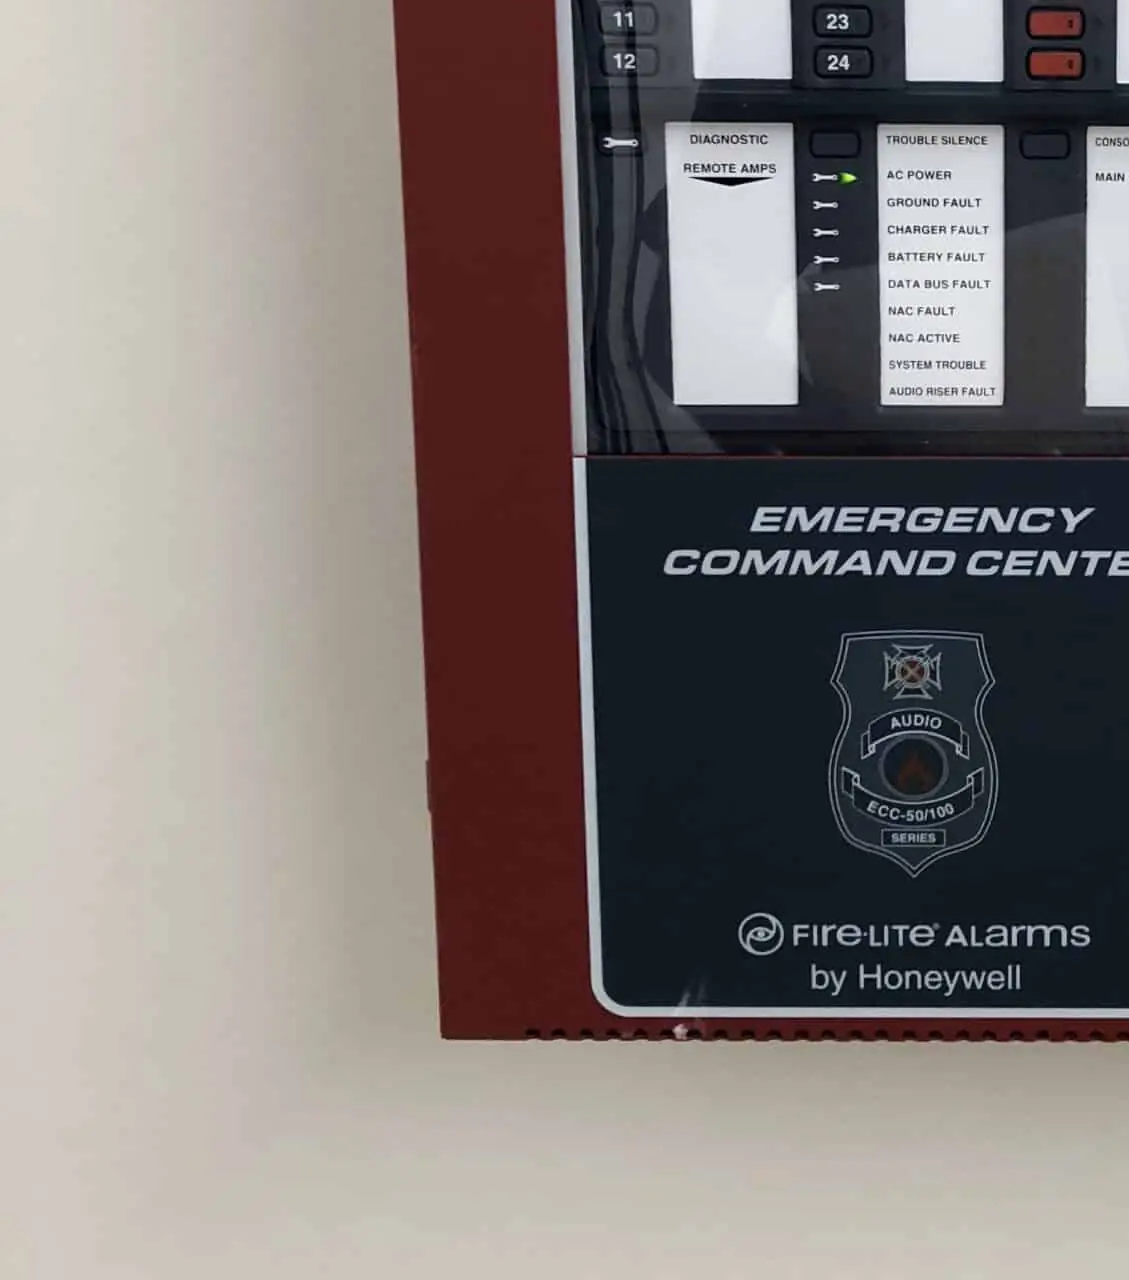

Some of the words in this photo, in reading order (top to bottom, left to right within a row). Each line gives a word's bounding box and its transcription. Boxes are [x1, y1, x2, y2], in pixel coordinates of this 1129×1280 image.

[613, 12, 633, 27] 11
[827, 14, 848, 29] 23
[613, 53, 635, 69] 12
[828, 55, 849, 70] 24
[689, 134, 769, 145] DIAGNOSTIC
[885, 135, 938, 145] TROUBLE
[940, 135, 988, 146] SILENCE
[683, 163, 737, 174] REMOTE
[740, 163, 777, 174] AMPS
[886, 170, 904, 181] AC
[907, 170, 952, 181] POWER
[1095, 172, 1126, 182] MAIN
[886, 197, 940, 208] GROUND
[943, 198, 982, 209] FAULT
[887, 224, 947, 235] CHARGER
[950, 225, 990, 236] FAULT
[887, 251, 943, 262] BATTERY
[946, 252, 985, 263] FAULT
[887, 279, 921, 289] DATA
[923, 279, 950, 290] BUS
[951, 279, 992, 290] FAULT
[888, 306, 914, 316] NAC
[916, 306, 956, 317] FAULT
[888, 333, 914, 343] NAC
[917, 333, 961, 344] ACTIVE
[888, 359, 933, 370] SYSTEM
[935, 360, 986, 370] TROUBLE
[888, 386, 924, 397] AUDIO
[925, 386, 959, 397] RISER
[961, 386, 996, 397] FAULT
[750, 507, 1095, 533] EMERGENCY
[664, 550, 956, 575] COMMAND
[891, 714, 942, 730] AUDIO
[867, 801, 955, 822] ECC-50/100
[891, 833, 936, 843] SERIES
[812, 964, 846, 996] by
[859, 964, 1021, 996] Honeywell
